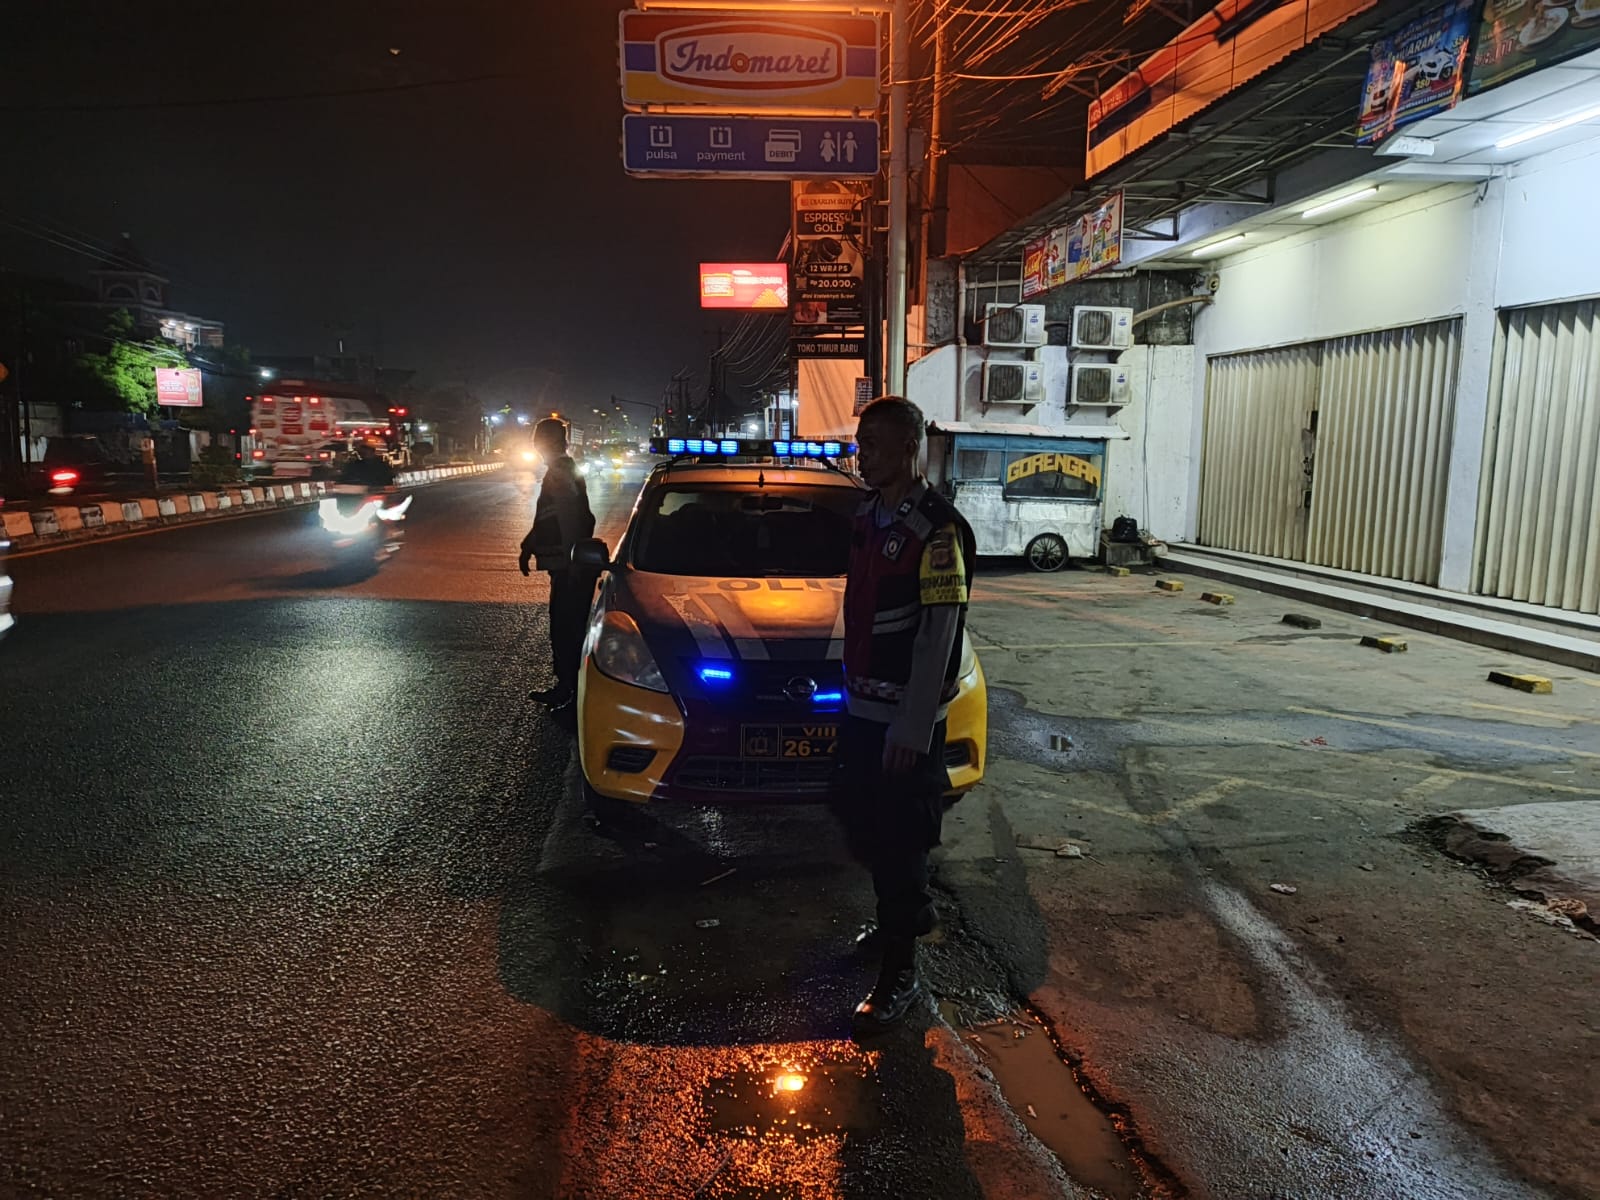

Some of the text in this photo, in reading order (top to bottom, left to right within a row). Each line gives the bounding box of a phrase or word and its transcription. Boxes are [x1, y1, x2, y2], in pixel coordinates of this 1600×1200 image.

[670, 40, 830, 74] Indomaret
[646, 148, 794, 162] pulsa payment DEBIT
[814, 223, 844, 233] GOLD
[810, 264, 848, 272] 12 WRAPS
[797, 343, 816, 353] TOKO
[817, 343, 839, 353] TIMUR
[1007, 452, 1101, 488] GORENGAN
